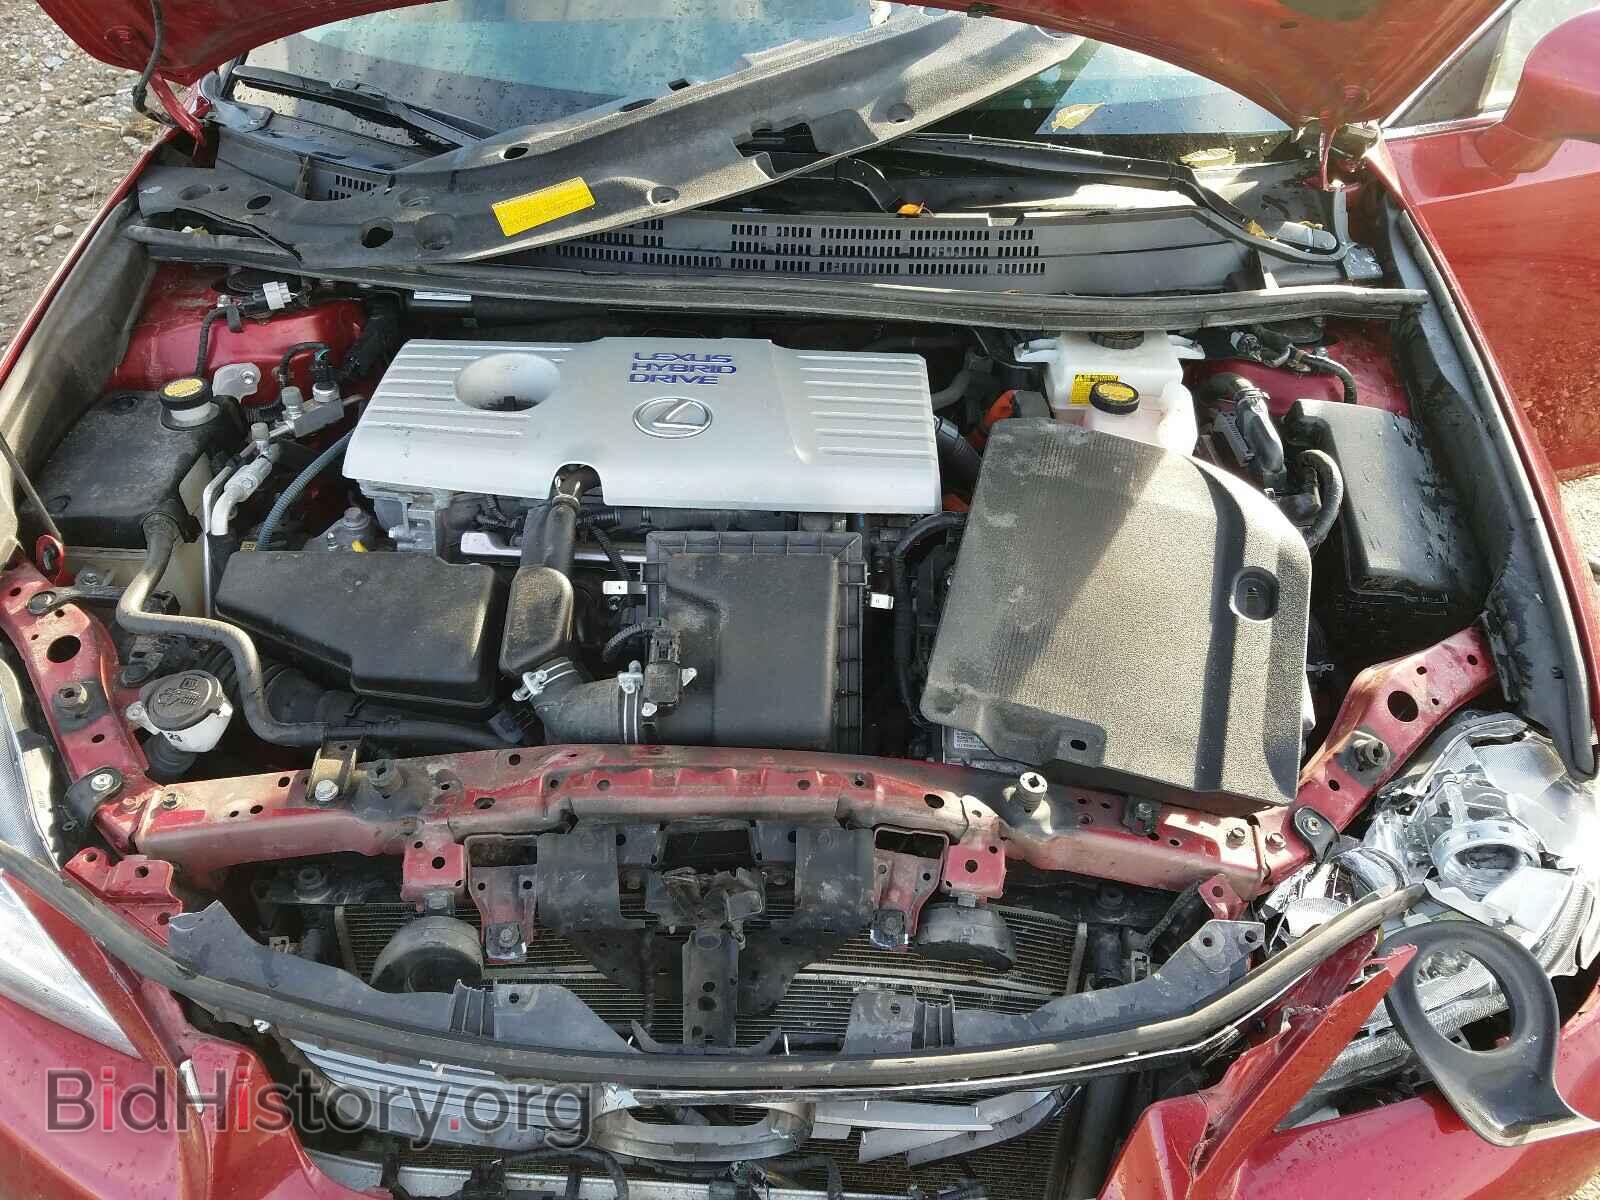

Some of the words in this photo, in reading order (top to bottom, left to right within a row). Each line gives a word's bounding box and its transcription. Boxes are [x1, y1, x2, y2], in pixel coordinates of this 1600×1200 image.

[633, 352, 733, 363] LEXUS
[631, 363, 737, 374] HYBRID
[628, 373, 719, 385] DRIVE
